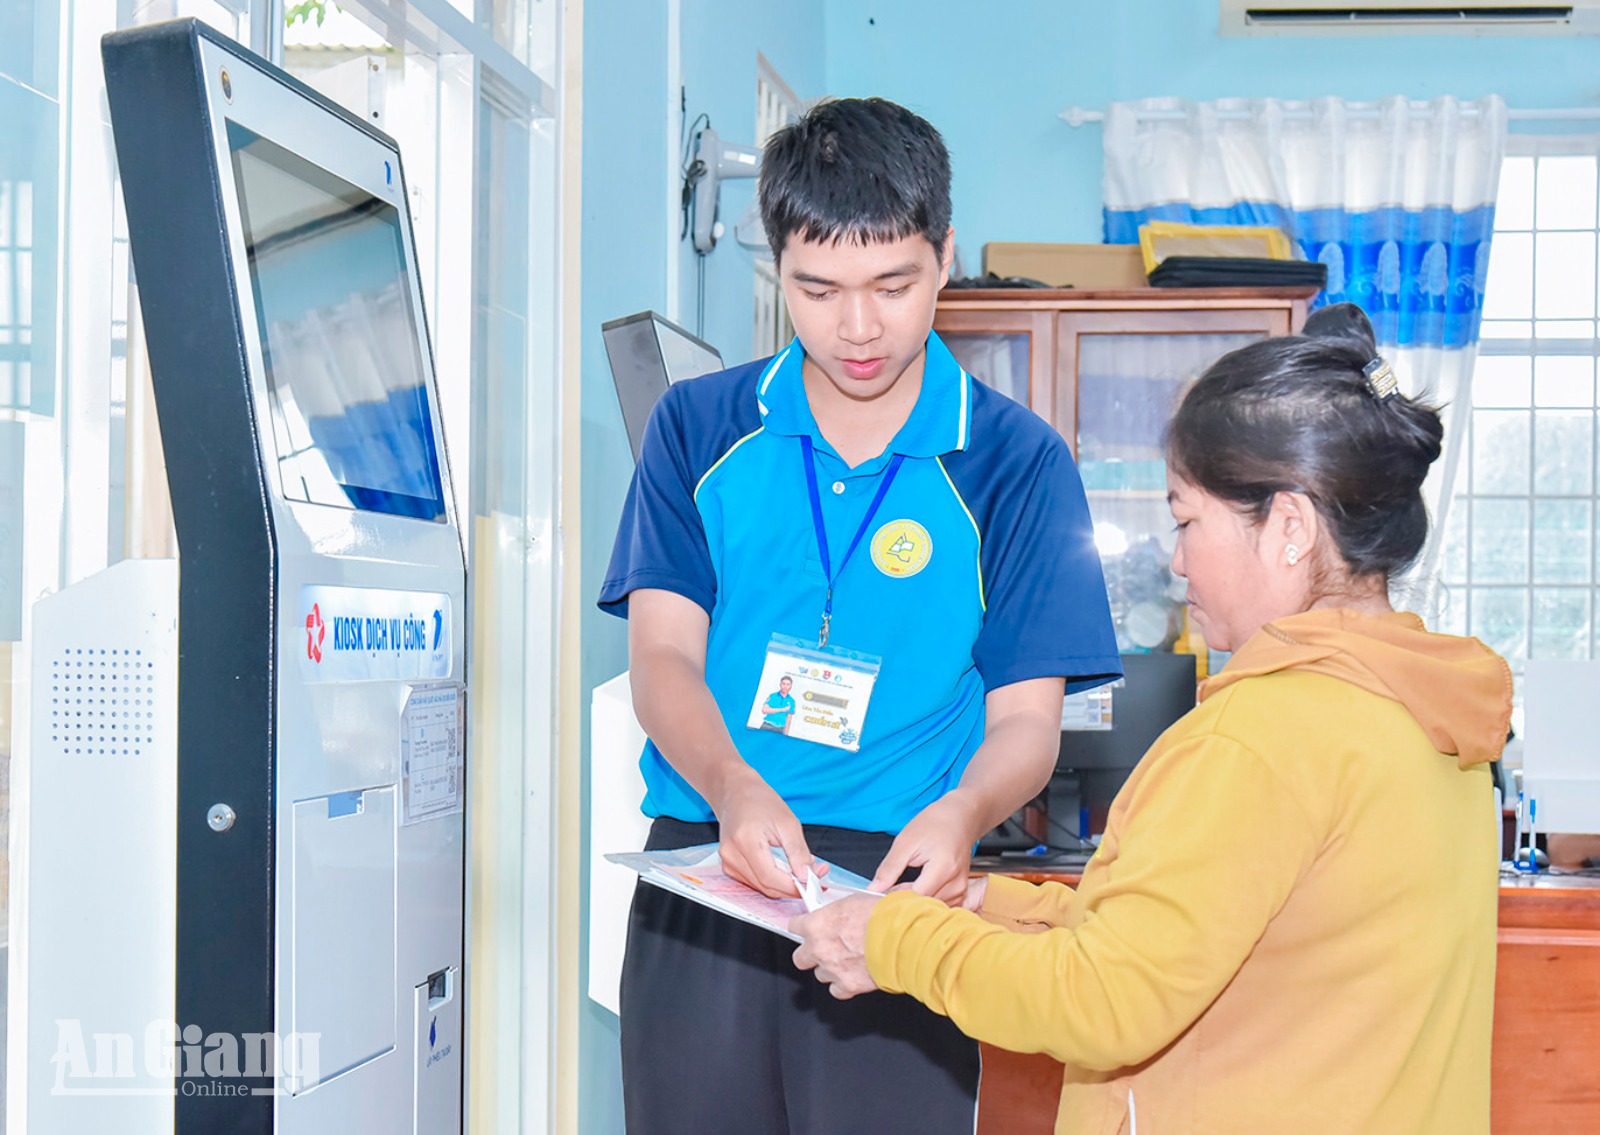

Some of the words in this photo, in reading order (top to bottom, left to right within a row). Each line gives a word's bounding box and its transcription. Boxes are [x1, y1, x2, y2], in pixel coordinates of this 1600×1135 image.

[334, 616, 364, 651] KIOSK
[365, 617, 388, 658] DỊCH
[389, 618, 401, 658] VỤ
[403, 612, 426, 651] CÔNG
